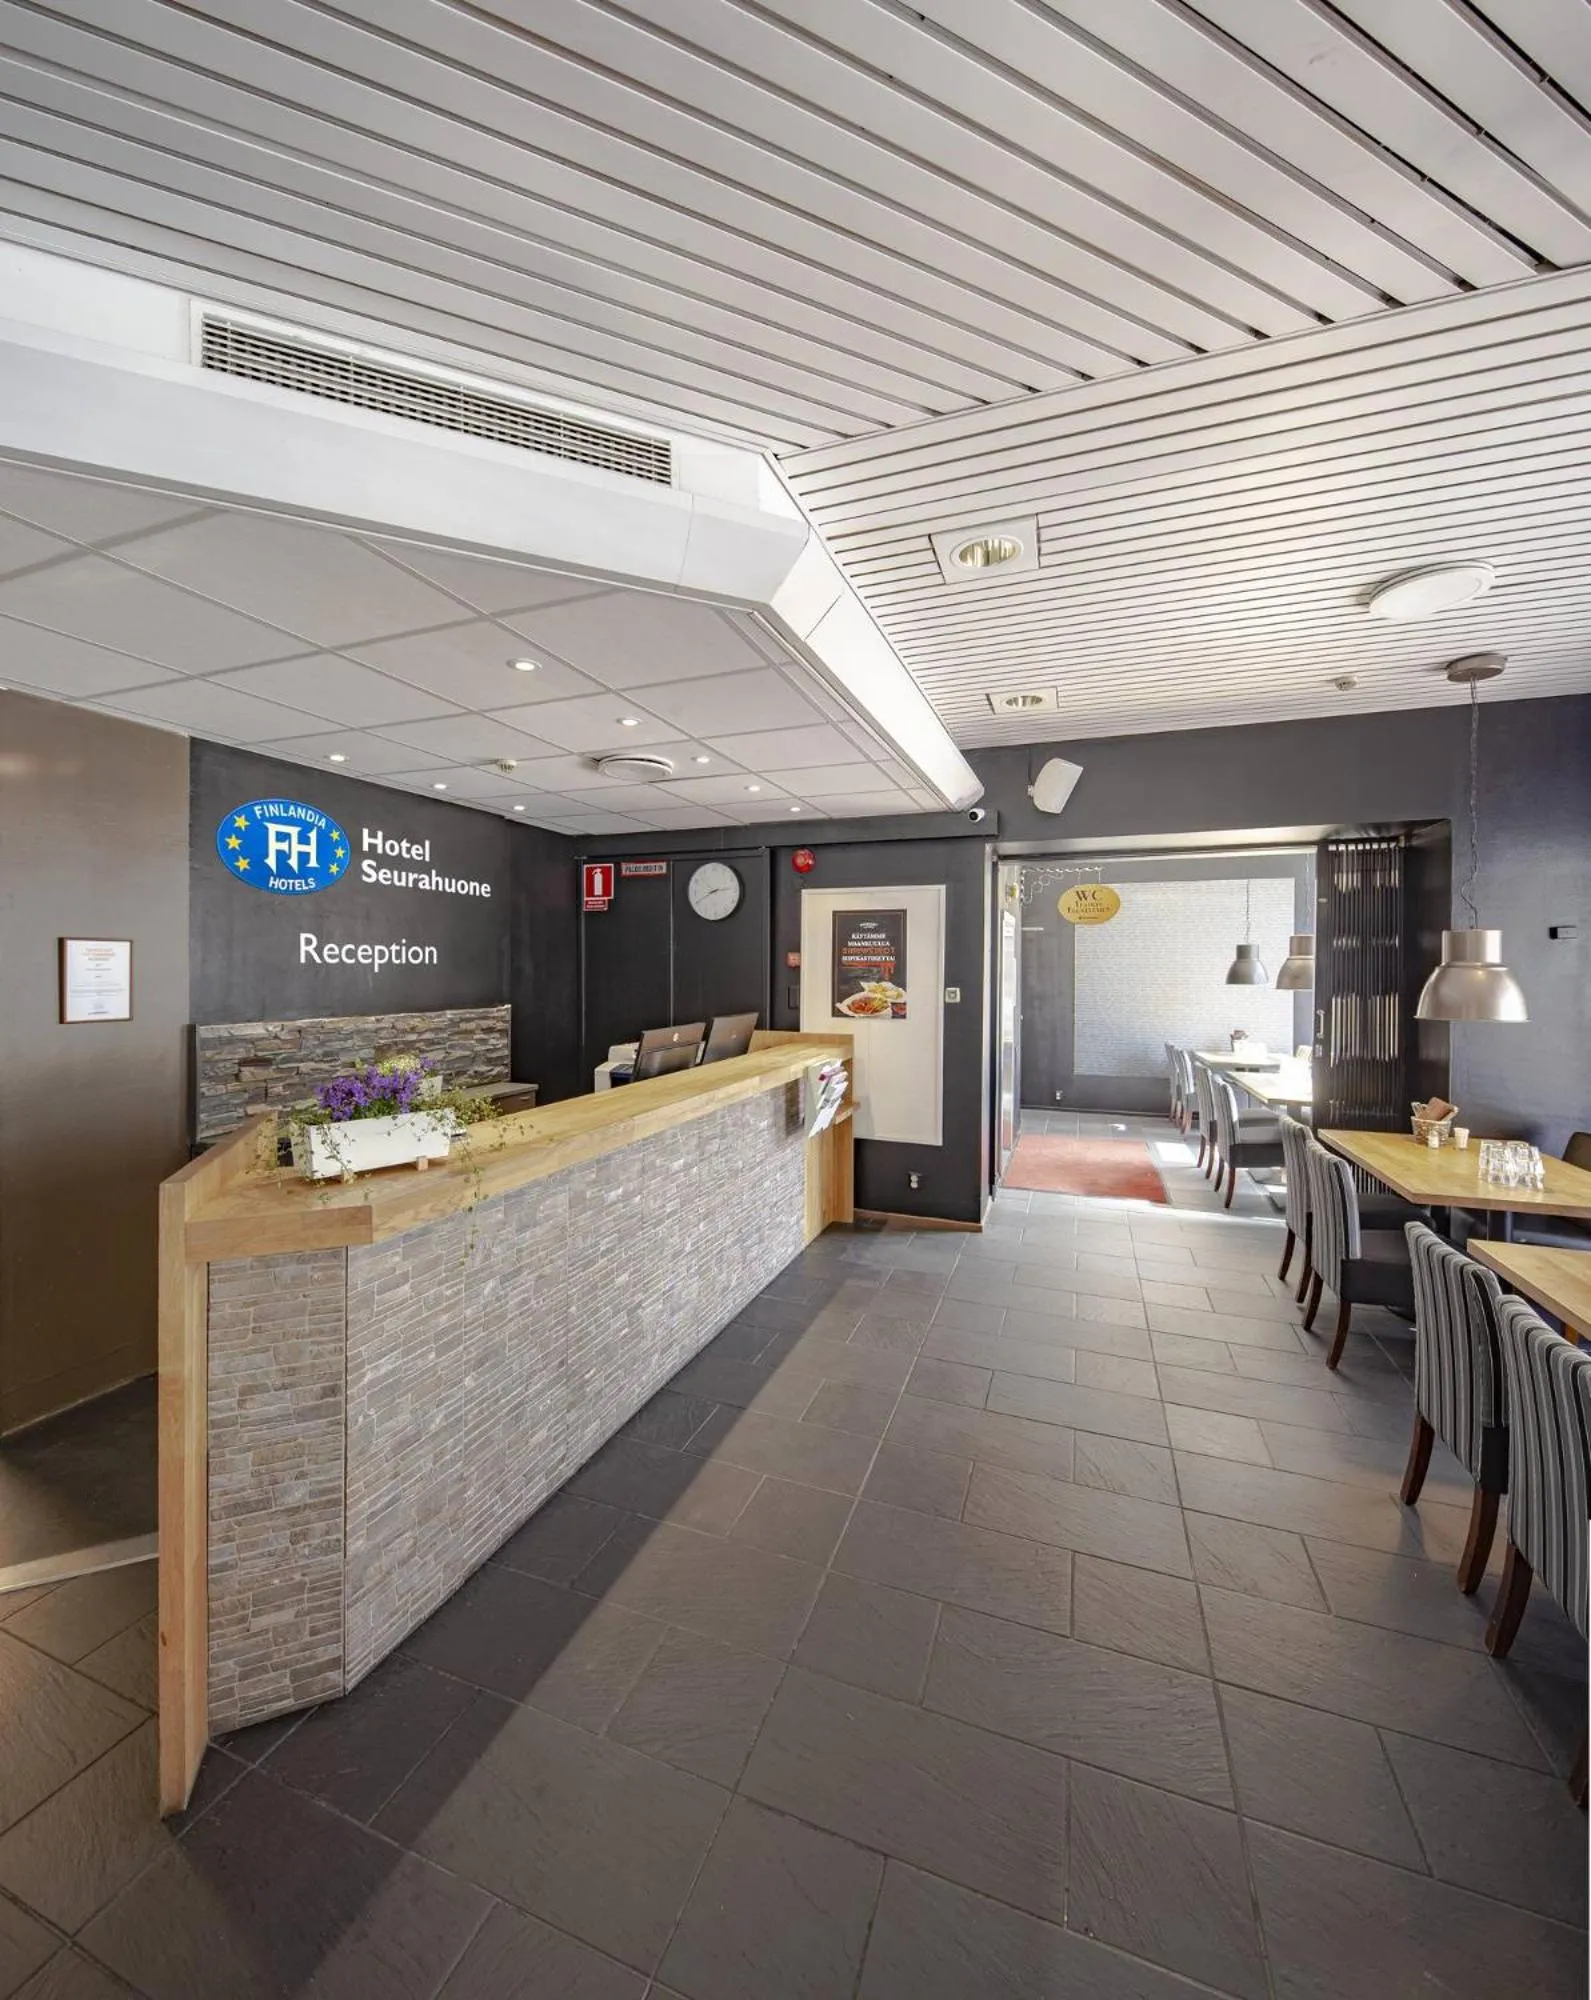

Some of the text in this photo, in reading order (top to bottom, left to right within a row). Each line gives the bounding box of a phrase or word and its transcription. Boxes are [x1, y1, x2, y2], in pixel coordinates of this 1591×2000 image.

[254, 804, 326, 829] FINLANDIA
[362, 828, 430, 862] Hotel
[268, 876, 316, 890] HOTELS
[361, 859, 492, 897] Seurahuone
[1075, 890, 1101, 901] WC
[299, 932, 437, 972] Reception
